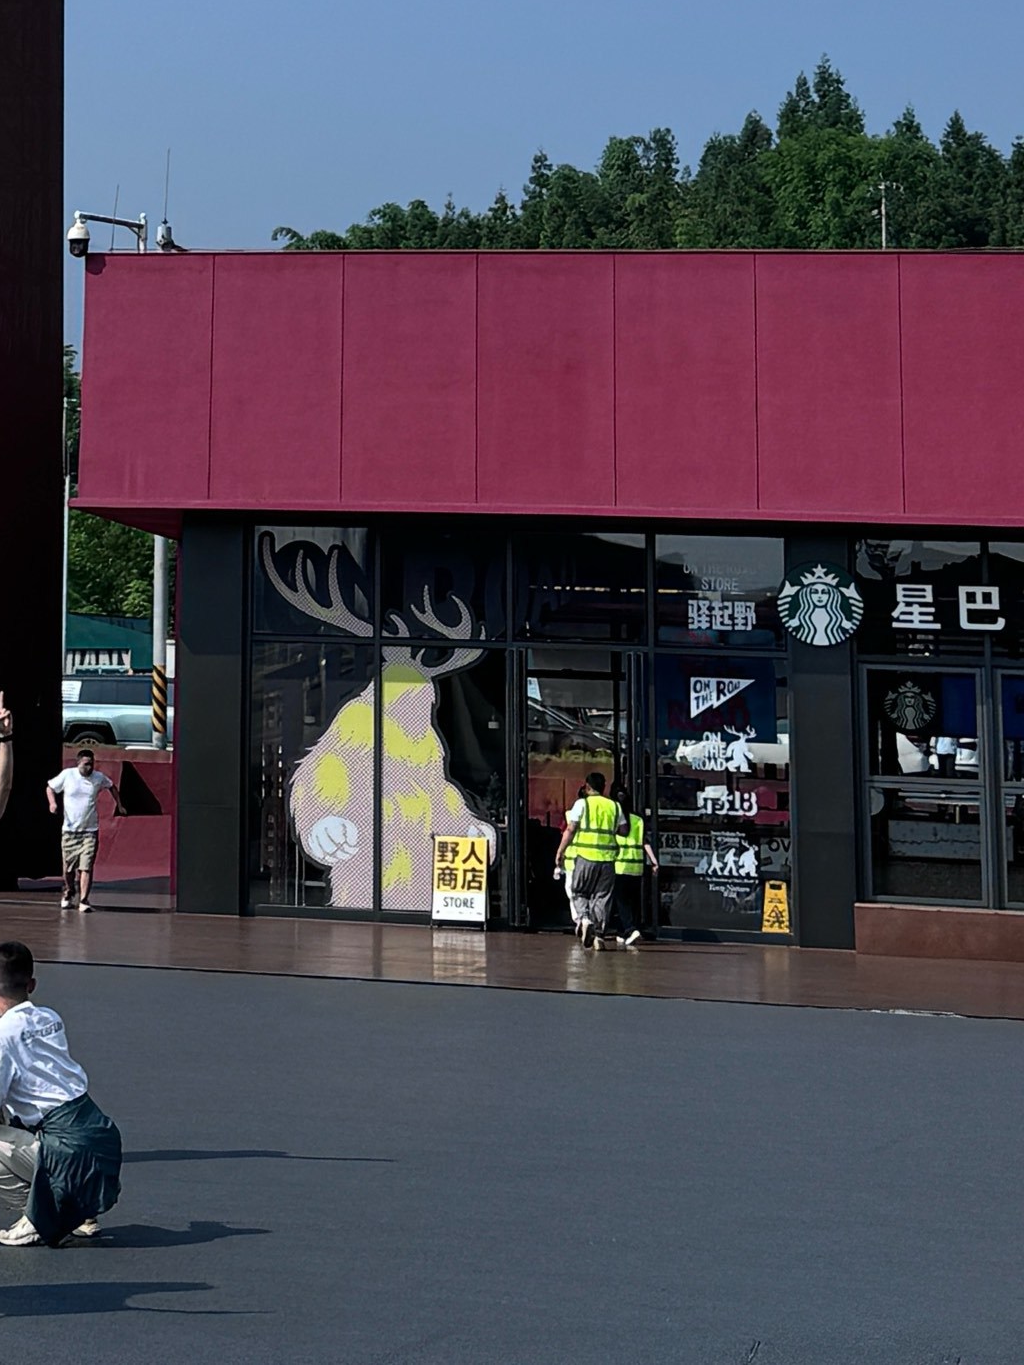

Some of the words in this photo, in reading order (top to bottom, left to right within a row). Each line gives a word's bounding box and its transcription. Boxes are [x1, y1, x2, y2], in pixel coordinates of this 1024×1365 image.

[701, 577, 739, 591] STORE
[687, 599, 757, 631] 驿起野
[891, 584, 1006, 630] 星巴
[693, 679, 711, 694] ON
[702, 731, 722, 744] ON
[437, 841, 483, 865] 野人
[437, 866, 484, 891] 商店
[443, 896, 475, 909] STORE
